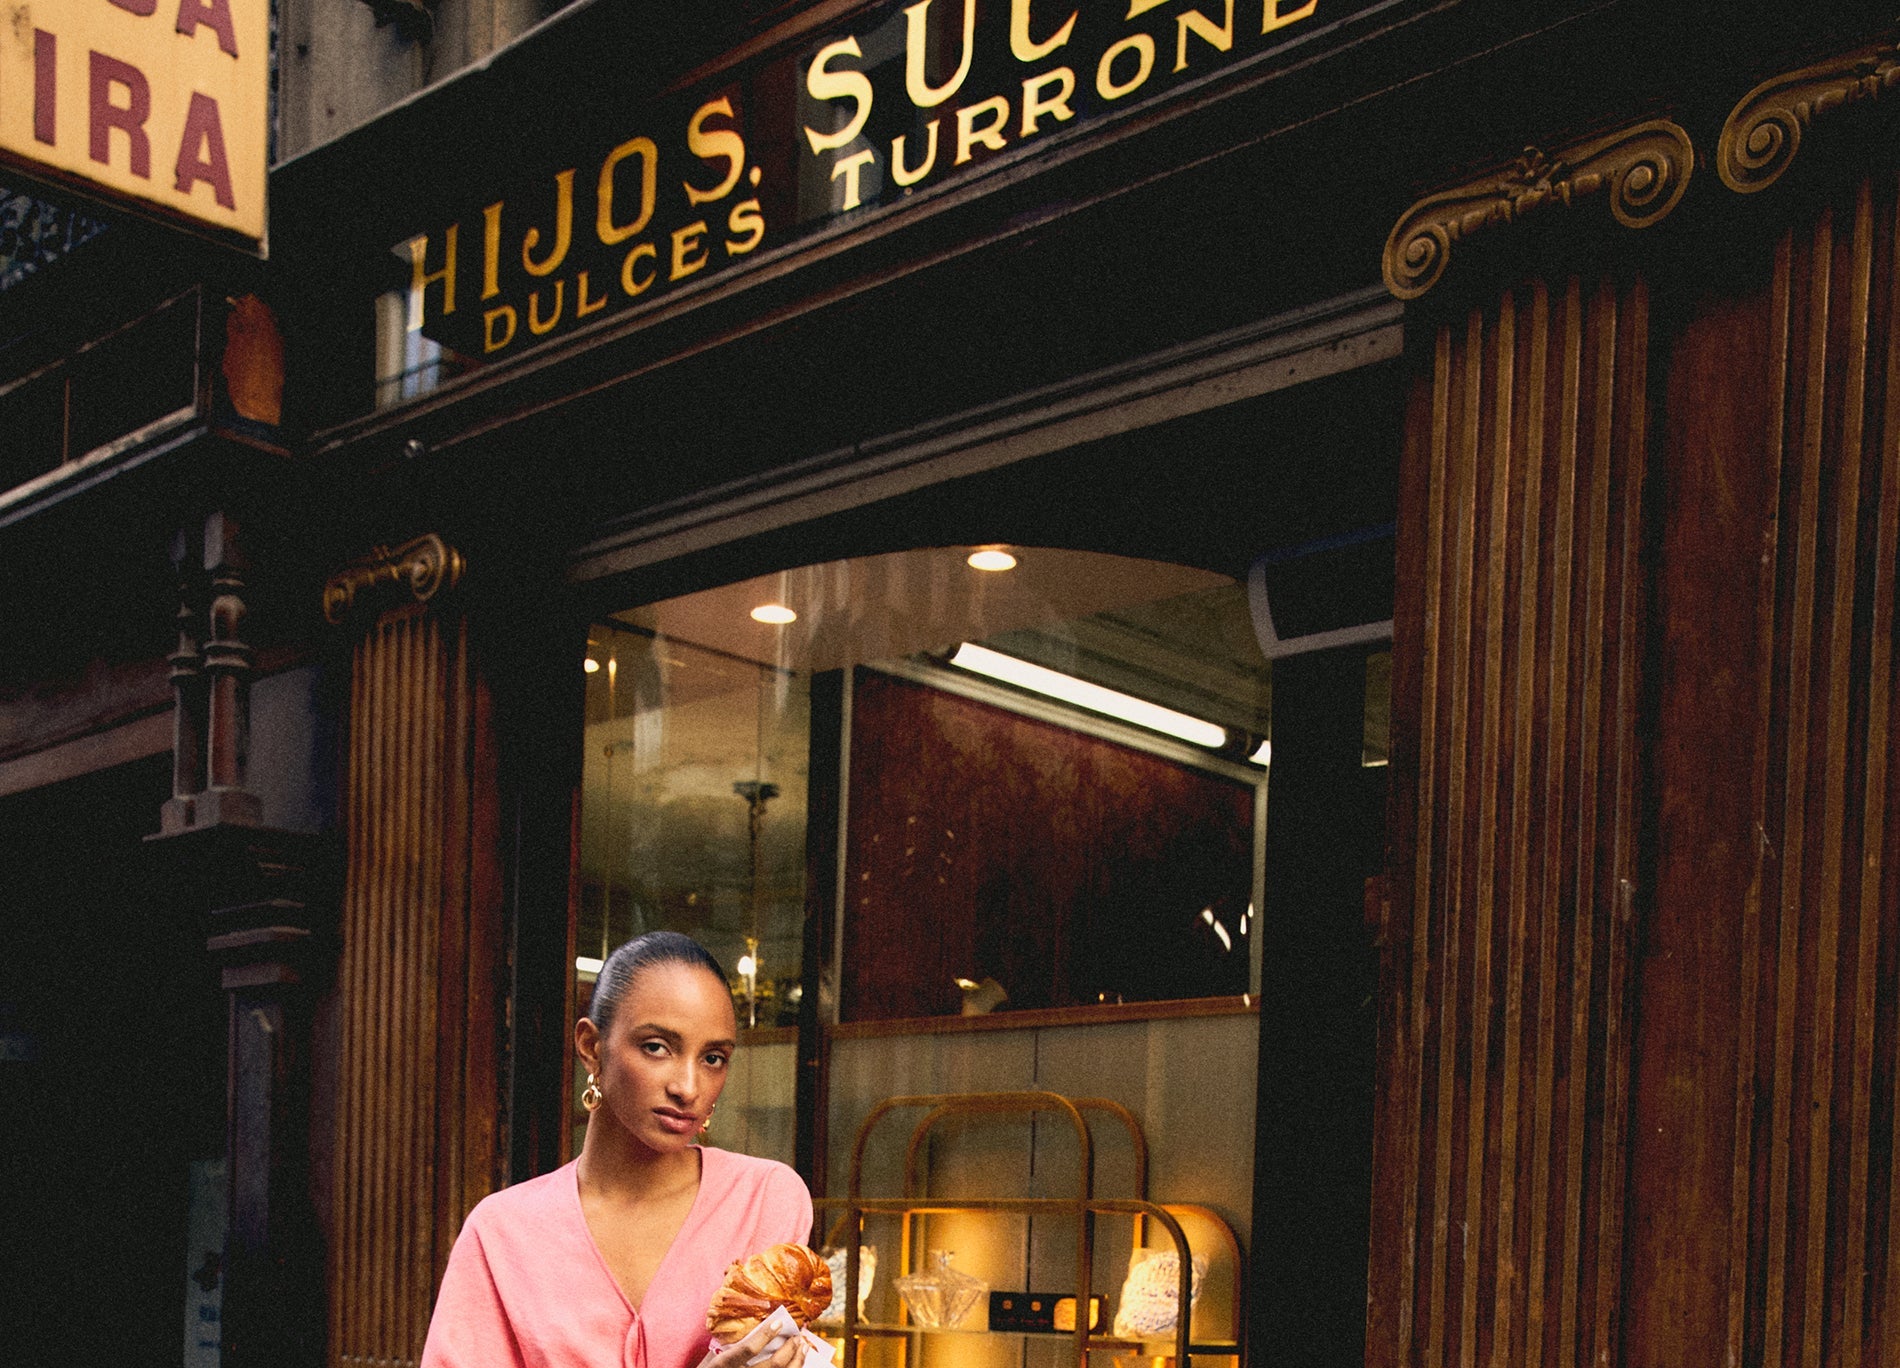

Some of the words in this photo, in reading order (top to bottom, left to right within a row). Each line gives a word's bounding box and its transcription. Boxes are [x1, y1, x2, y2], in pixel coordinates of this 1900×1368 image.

[33, 28, 237, 212] IRA
[407, 96, 762, 333] HIJOS.
[804, 0, 1172, 155] SUC
[483, 198, 766, 354] DULCES
